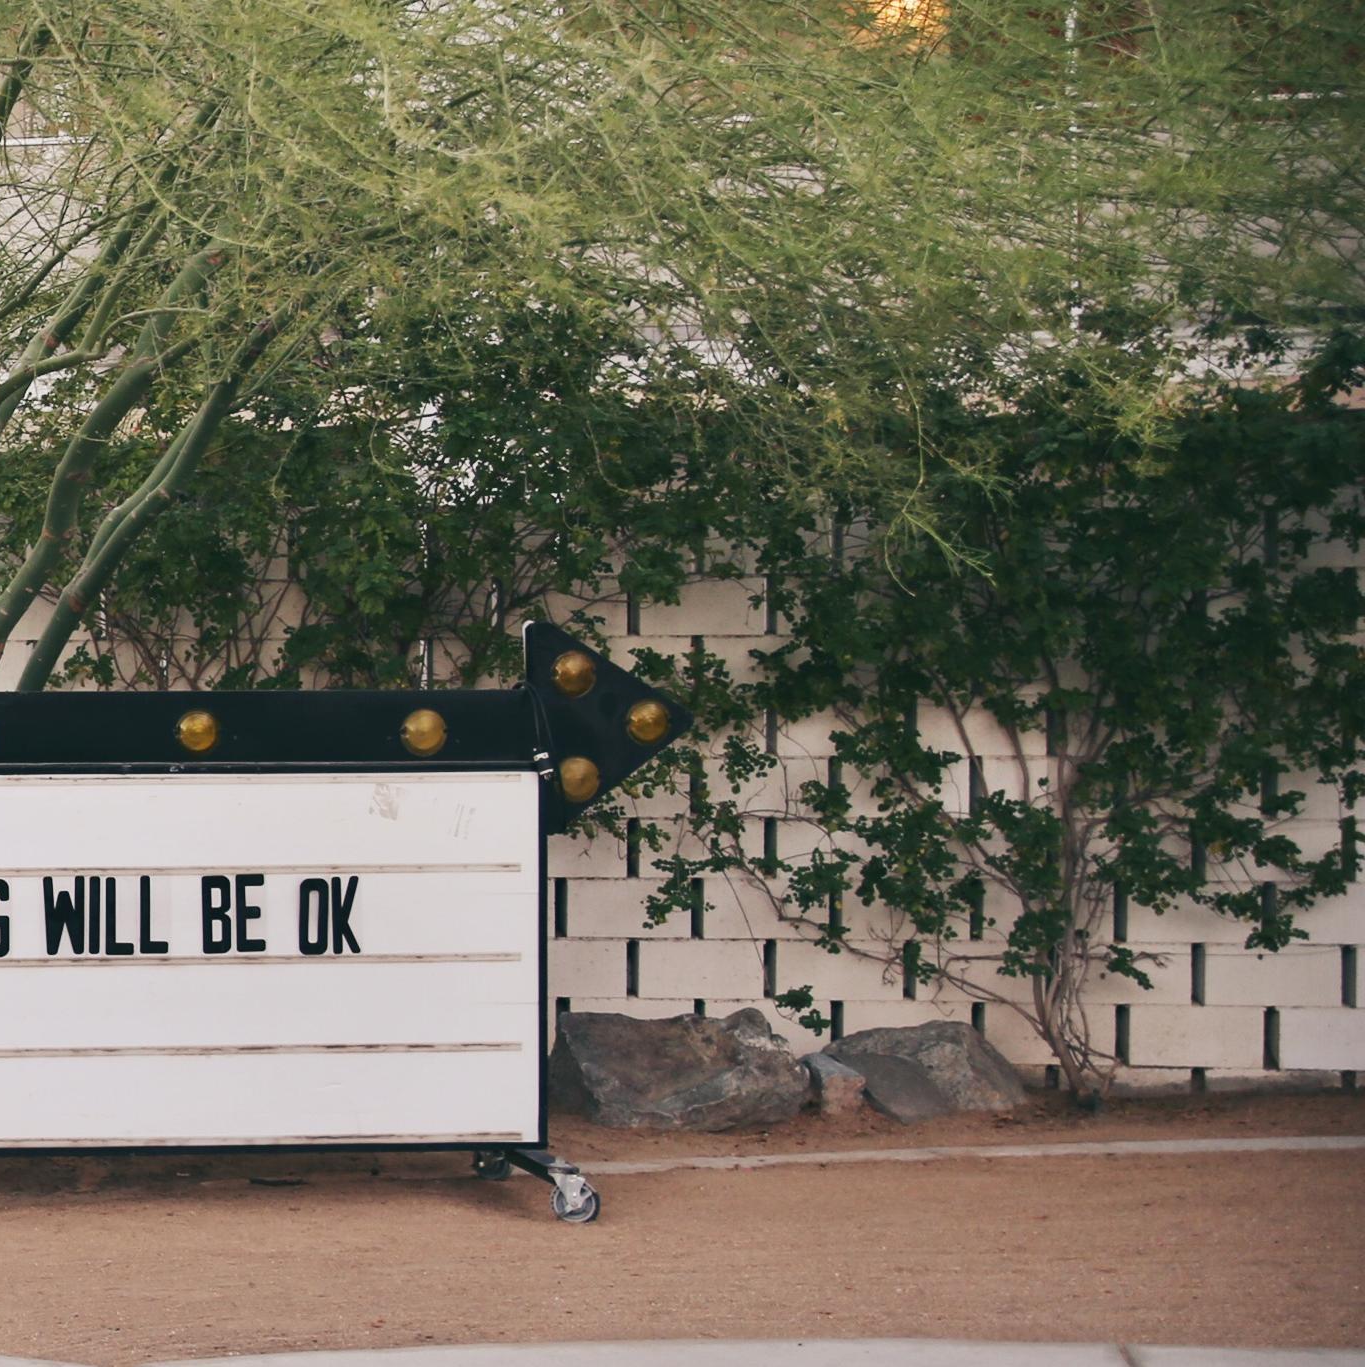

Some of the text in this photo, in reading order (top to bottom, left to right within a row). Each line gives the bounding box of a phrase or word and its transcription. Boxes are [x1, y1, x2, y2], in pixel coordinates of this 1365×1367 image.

[42, 875, 169, 957] WILL
[202, 873, 267, 954] BE
[298, 875, 362, 957] OK
